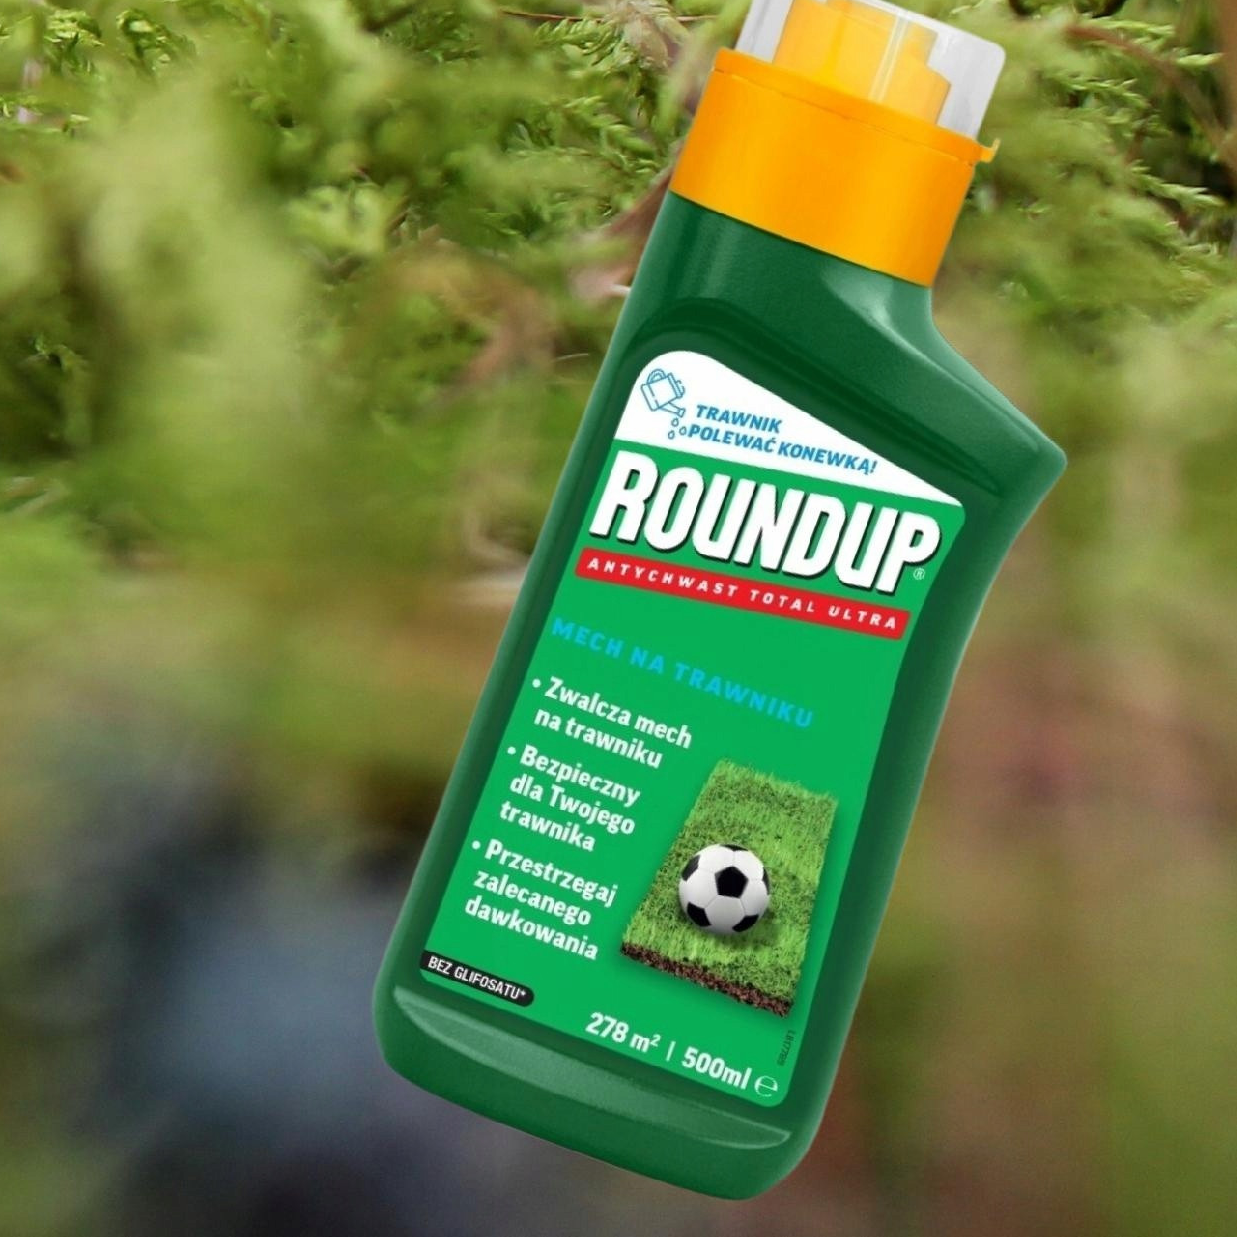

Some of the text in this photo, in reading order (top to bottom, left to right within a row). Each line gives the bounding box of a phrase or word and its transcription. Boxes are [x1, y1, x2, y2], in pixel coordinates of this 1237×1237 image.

[688, 423, 878, 475] POLEWAĆ KONEWKĄ!
[696, 404, 782, 434] TRAWNIK
[587, 557, 897, 630] ANTYCHWAST TOTAL ULTRA
[552, 617, 813, 728] MECH NA TRAWNIKU
[534, 709, 663, 769] na trawniku
[545, 676, 692, 748] Zwalcza mech
[510, 774, 636, 835] dla Twojego
[520, 744, 640, 807] Bezpieczny
[500, 801, 595, 851] trawnika
[474, 870, 591, 925] zalecanego
[485, 839, 618, 908] Przestrzegaj
[465, 895, 599, 960] dawkowania
[428, 955, 453, 974] BEZ
[586, 1012, 629, 1043] 278
[681, 1046, 752, 1089] 500ml
